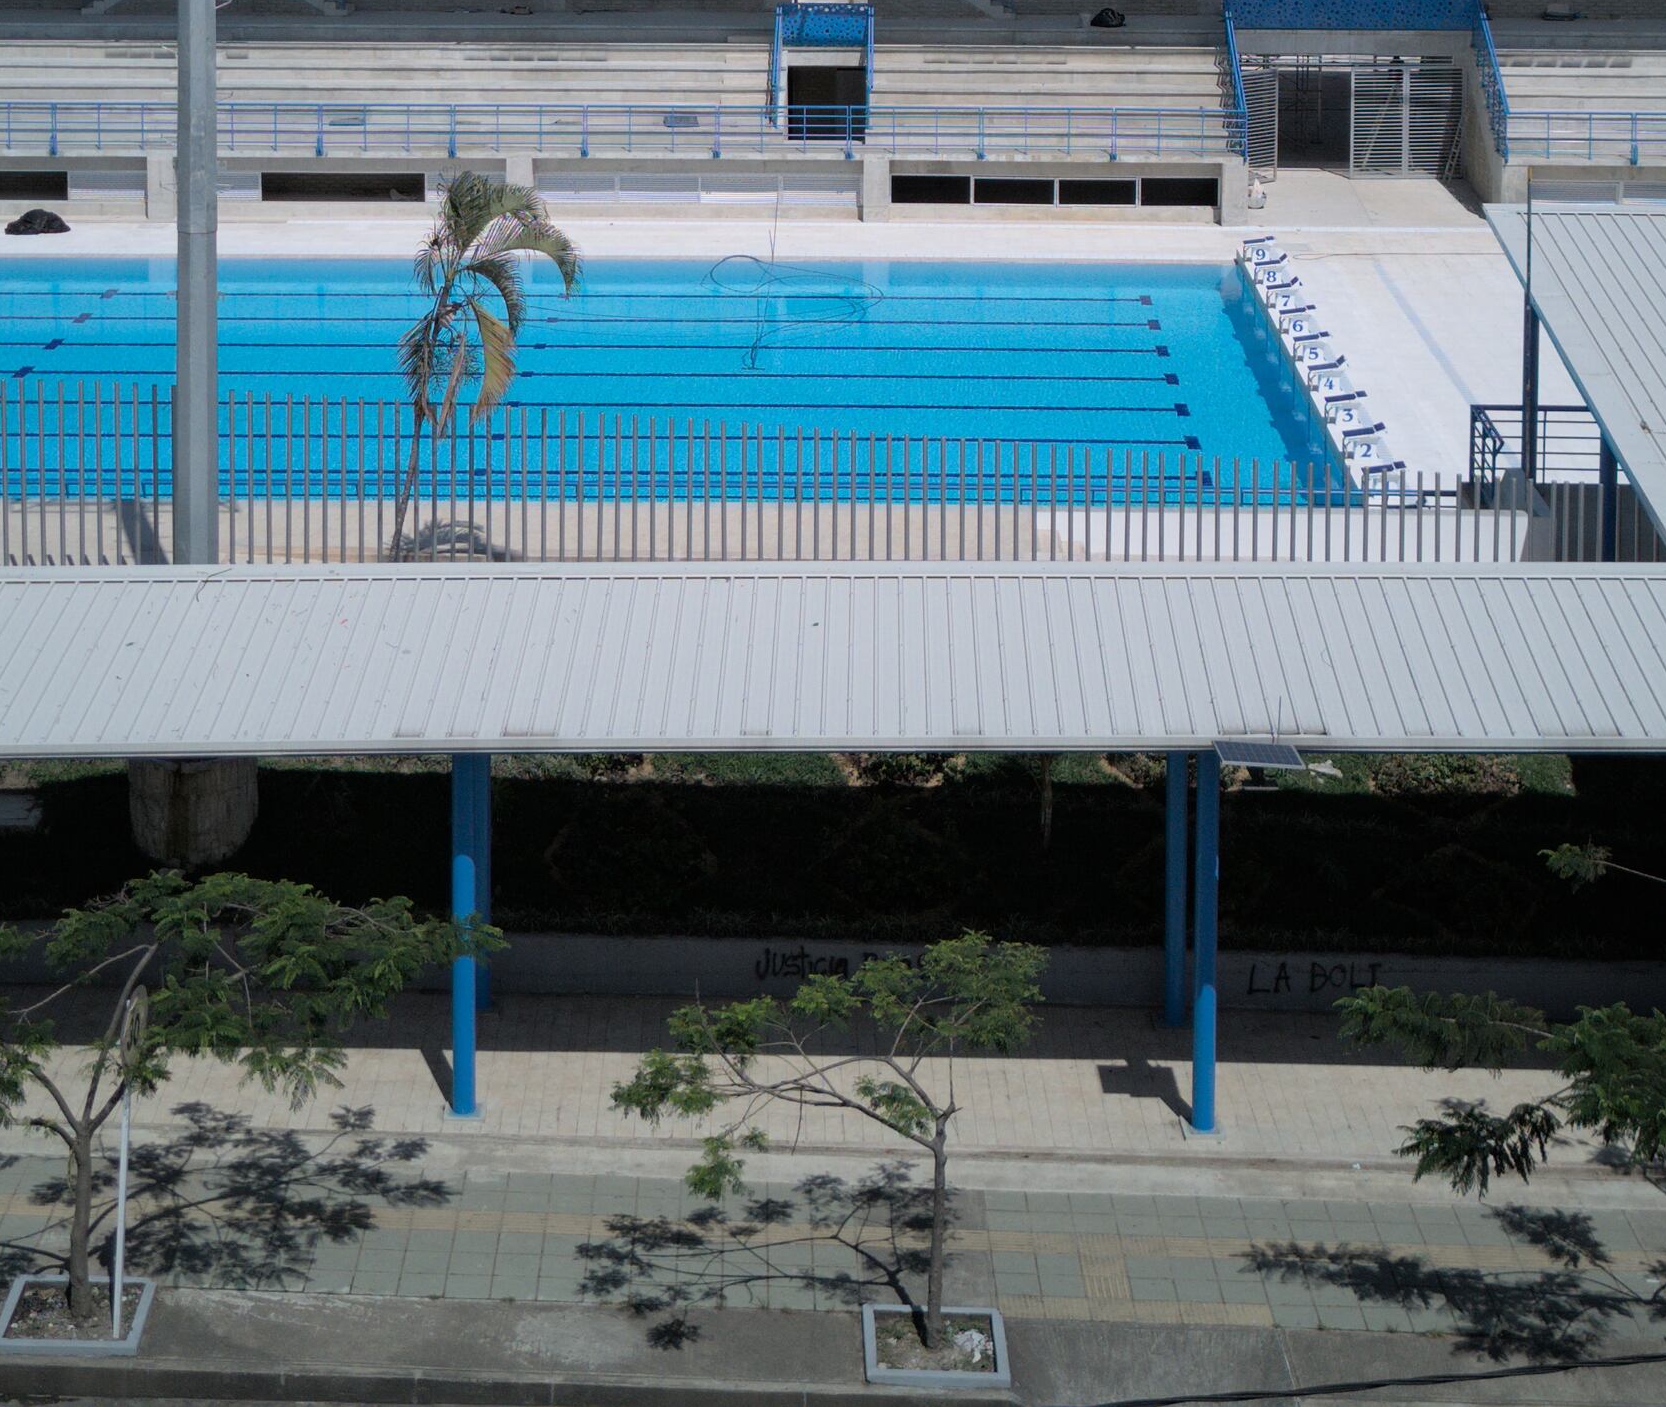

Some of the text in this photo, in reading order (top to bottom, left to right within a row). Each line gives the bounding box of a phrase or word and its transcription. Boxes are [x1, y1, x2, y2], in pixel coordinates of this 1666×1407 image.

[1255, 248, 1266, 260] 9
[1266, 271, 1277, 282] 8
[1281, 295, 1291, 307] 7
[1292, 319, 1303, 332] 6
[1308, 347, 1319, 360] 5
[1323, 377, 1334, 390] 4
[1342, 408, 1354, 422] 3
[1360, 443, 1372, 458] 2
[1247, 961, 1291, 994] LA
